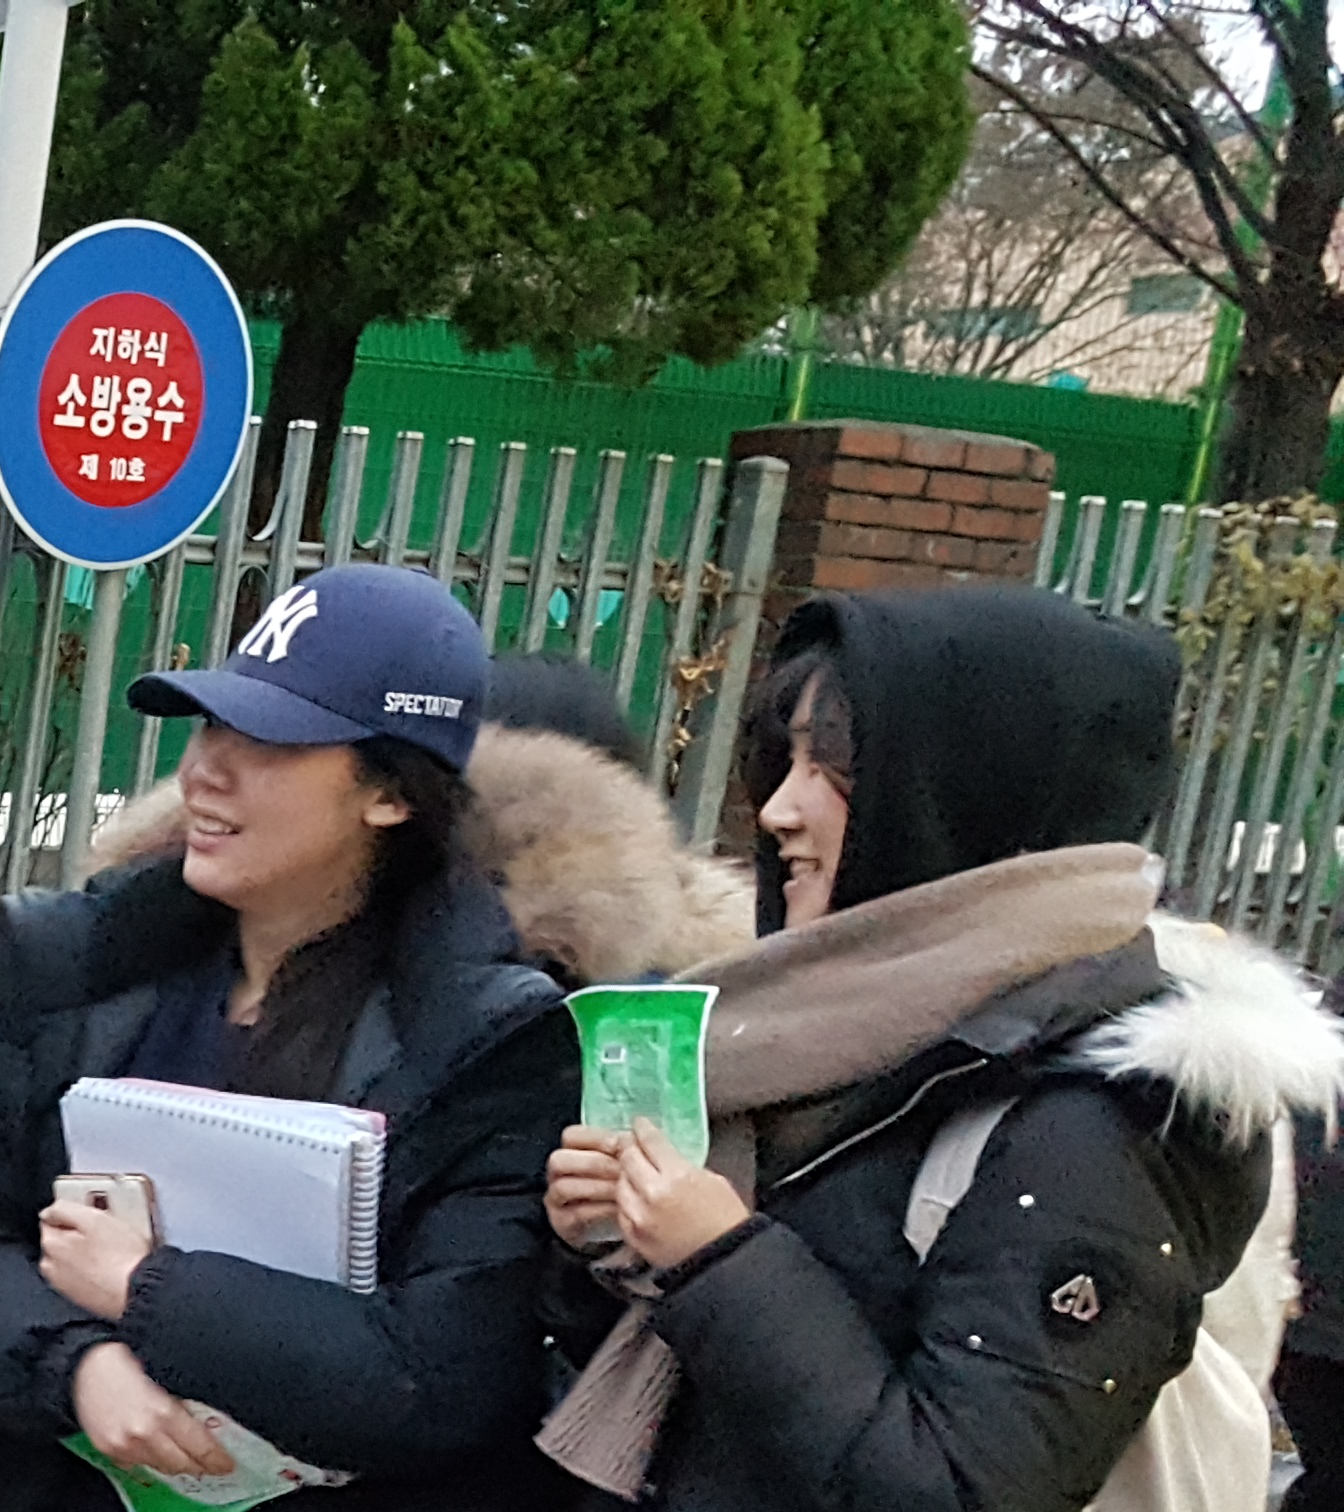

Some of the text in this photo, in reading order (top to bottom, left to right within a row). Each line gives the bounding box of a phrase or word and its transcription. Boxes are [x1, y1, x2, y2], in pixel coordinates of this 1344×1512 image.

[89, 326, 168, 367] 지하식
[53, 373, 185, 441] 소방용수
[77, 453, 146, 483] 제 10호
[238, 584, 318, 665] NY
